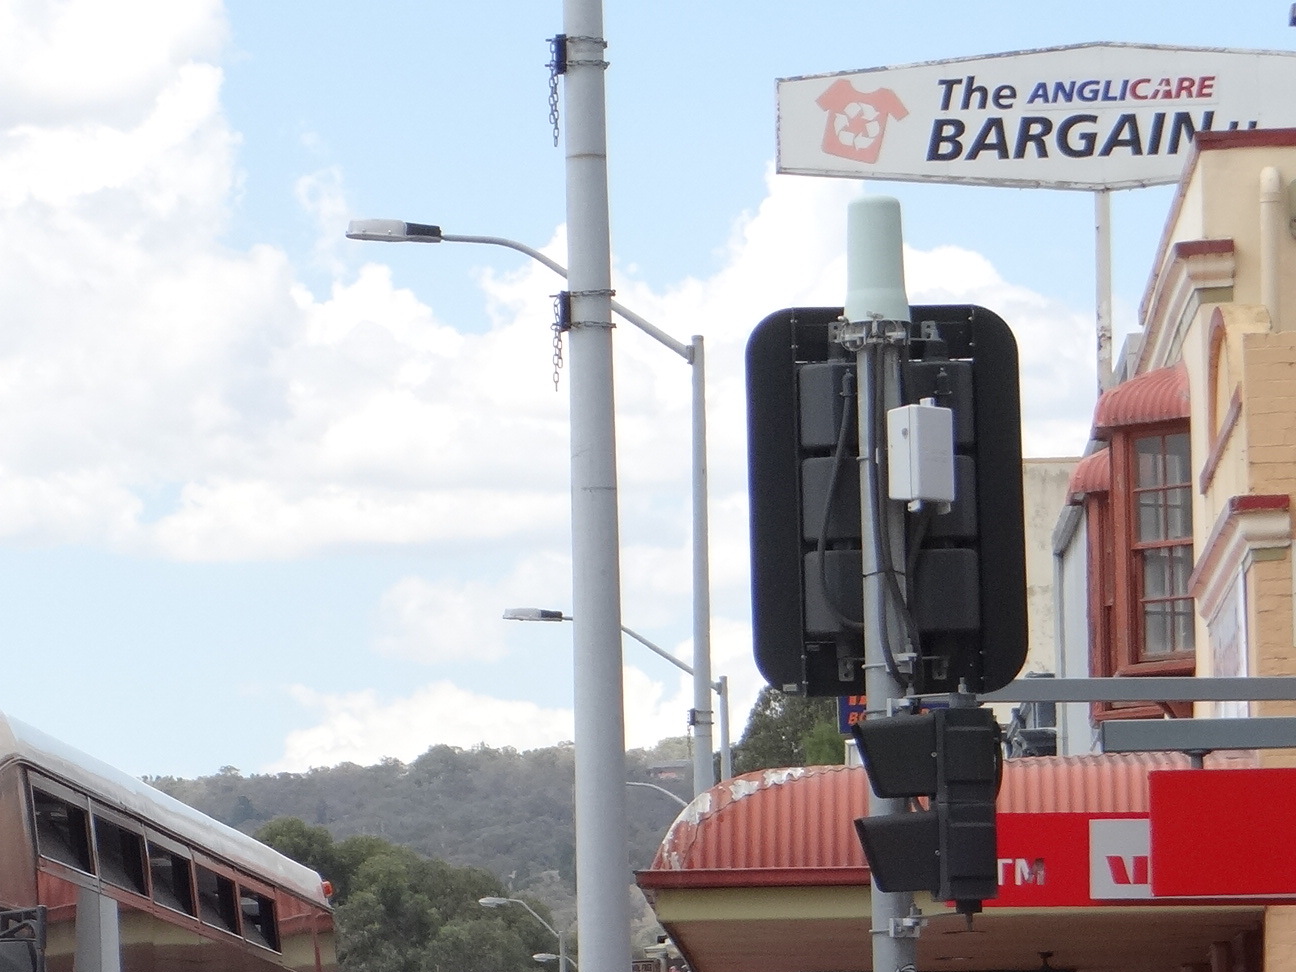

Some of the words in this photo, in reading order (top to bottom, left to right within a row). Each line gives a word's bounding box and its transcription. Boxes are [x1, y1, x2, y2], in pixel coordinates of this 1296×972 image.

[937, 76, 1017, 110] The
[1026, 75, 1216, 104] ANGLICARE
[997, 858, 1045, 886] TM
